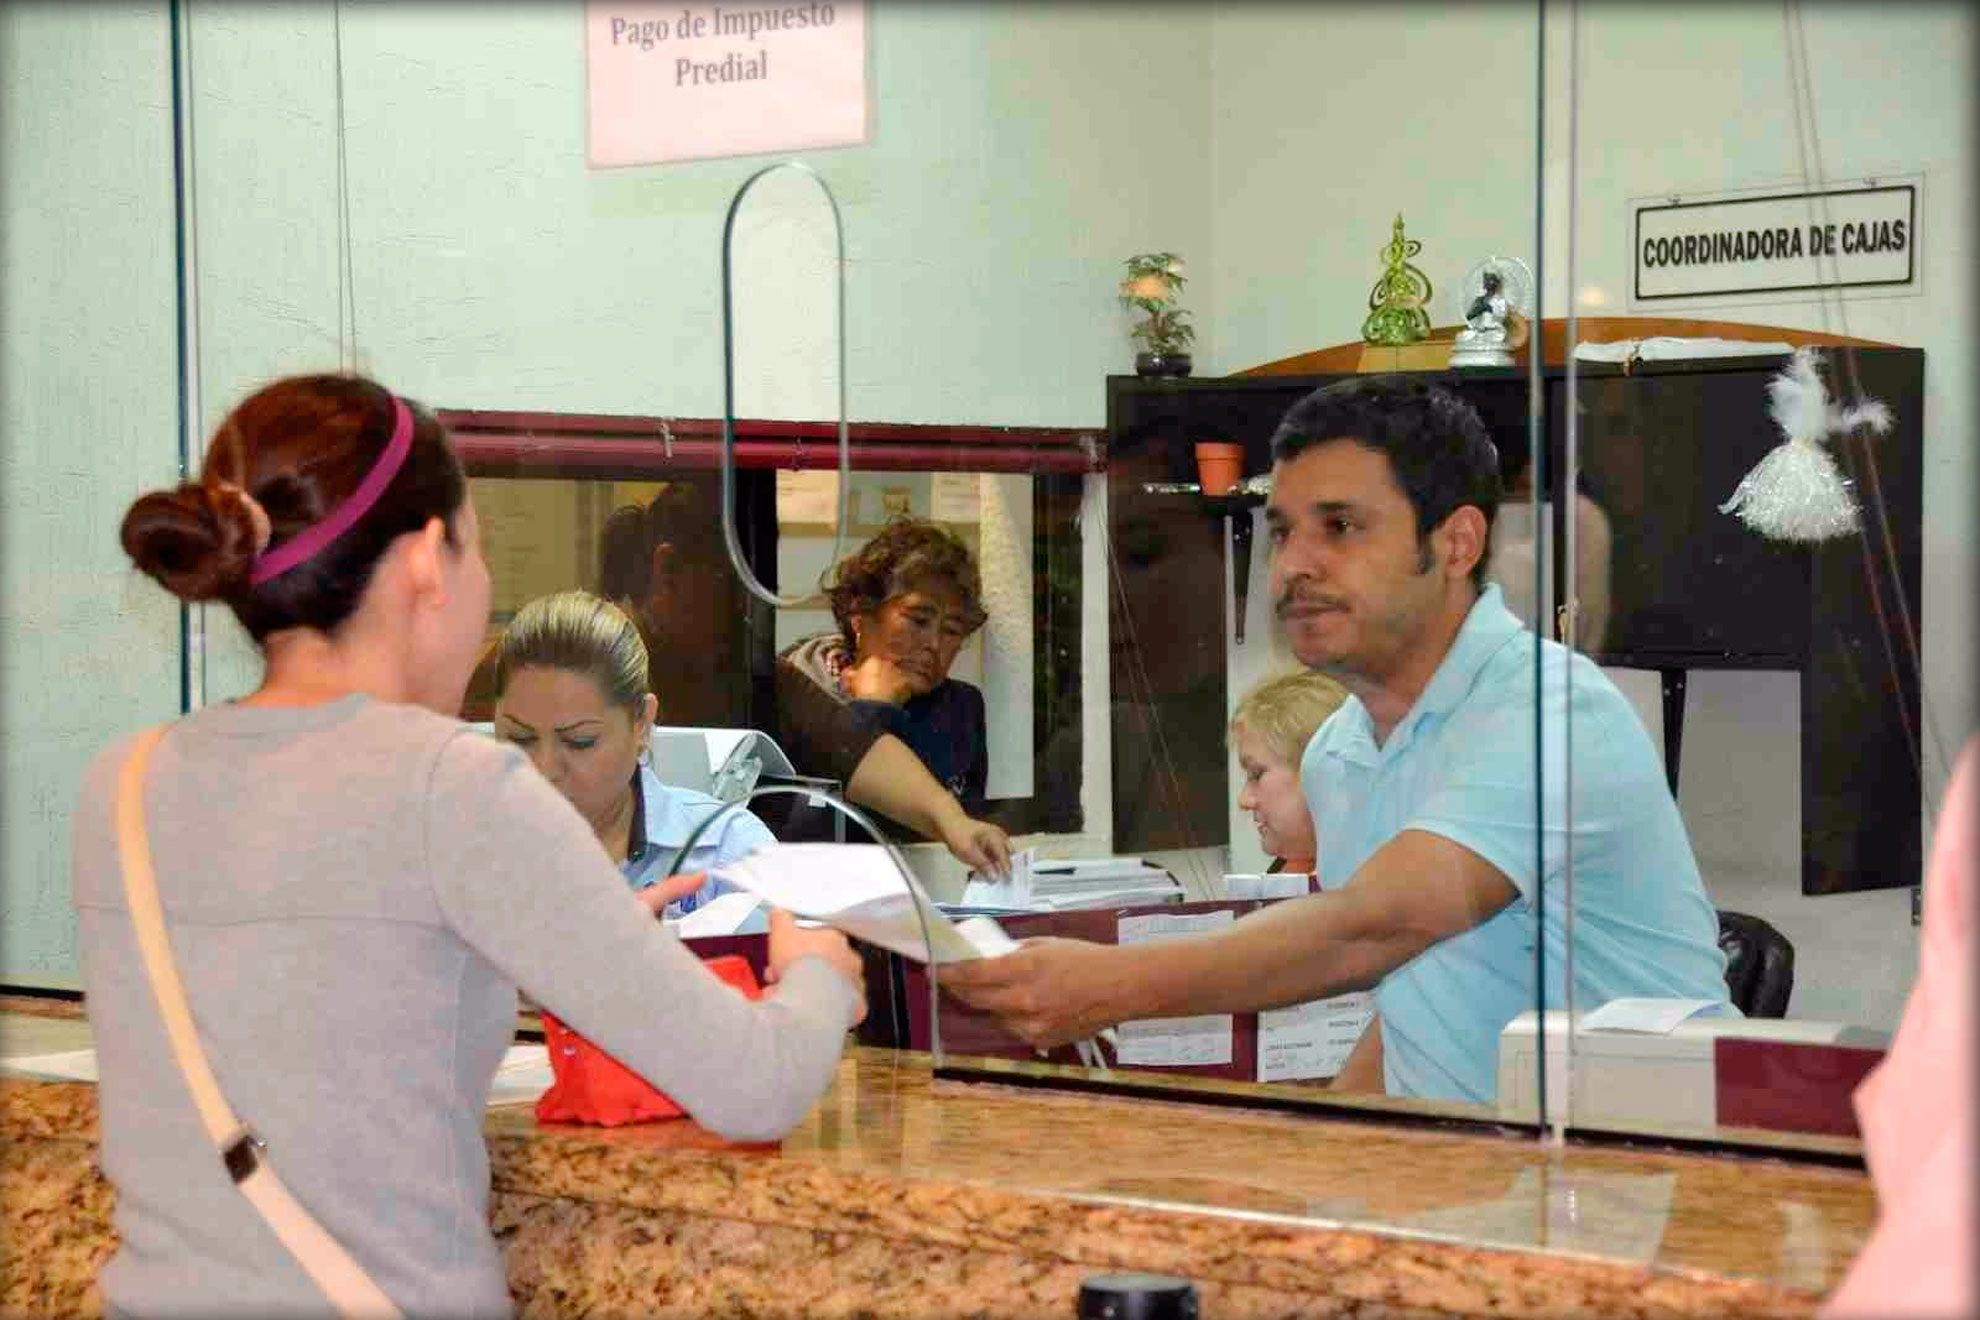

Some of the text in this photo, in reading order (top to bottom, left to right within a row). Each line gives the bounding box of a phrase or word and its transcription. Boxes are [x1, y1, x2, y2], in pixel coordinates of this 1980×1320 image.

[611, 1, 834, 50] Pago de Impuesto
[675, 50, 768, 87] Predial
[1643, 219, 1906, 268] COORDINADORA DE CAJAS
